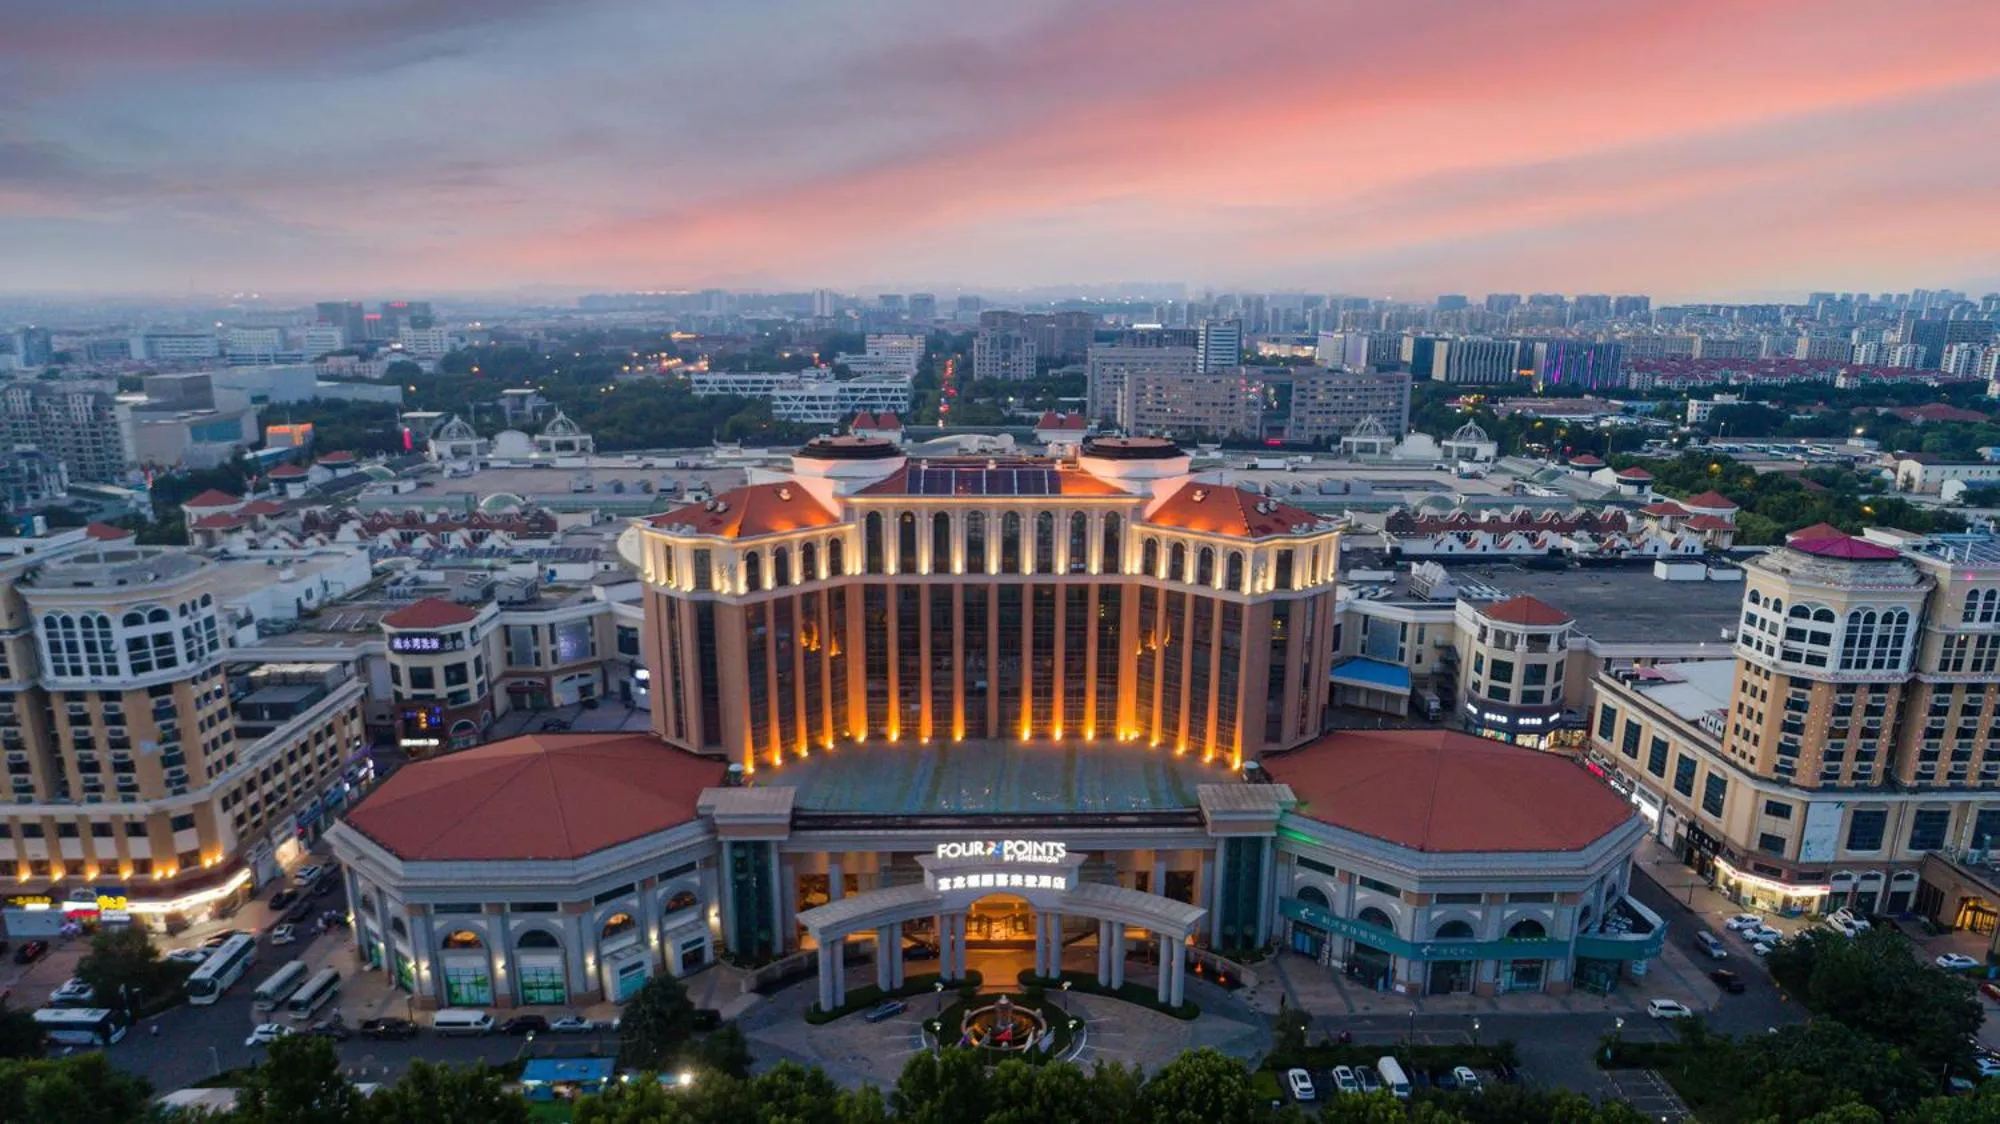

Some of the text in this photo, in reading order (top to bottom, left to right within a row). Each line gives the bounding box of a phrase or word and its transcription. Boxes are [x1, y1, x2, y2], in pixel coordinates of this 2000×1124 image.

[937, 839, 1067, 859] FOUR POINTS
[1003, 855, 1014, 863] BY
